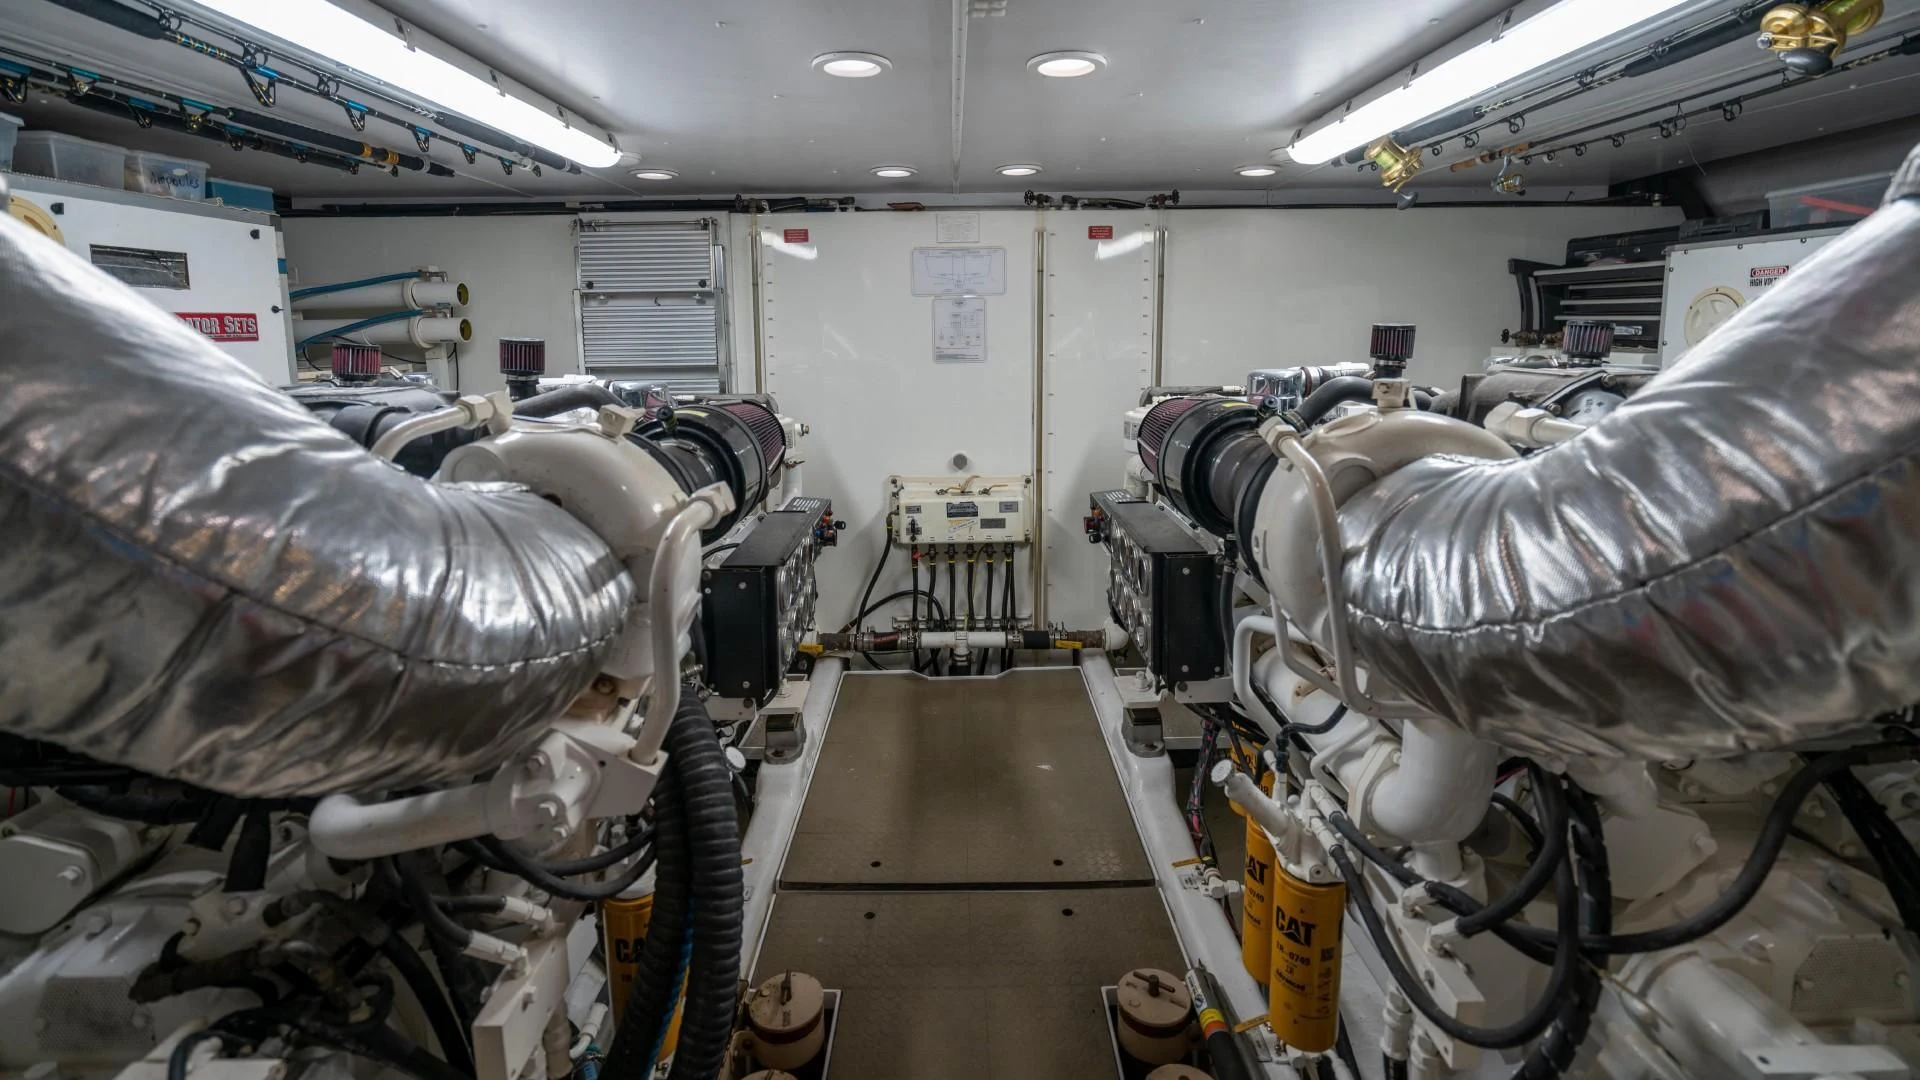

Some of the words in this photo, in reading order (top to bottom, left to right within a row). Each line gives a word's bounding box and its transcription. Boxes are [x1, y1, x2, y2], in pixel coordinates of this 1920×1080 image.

[1755, 268, 1784, 276] DANGER
[1750, 278, 1762, 287] HIGH
[1246, 854, 1269, 886] AT
[1276, 905, 1317, 948] CAT
